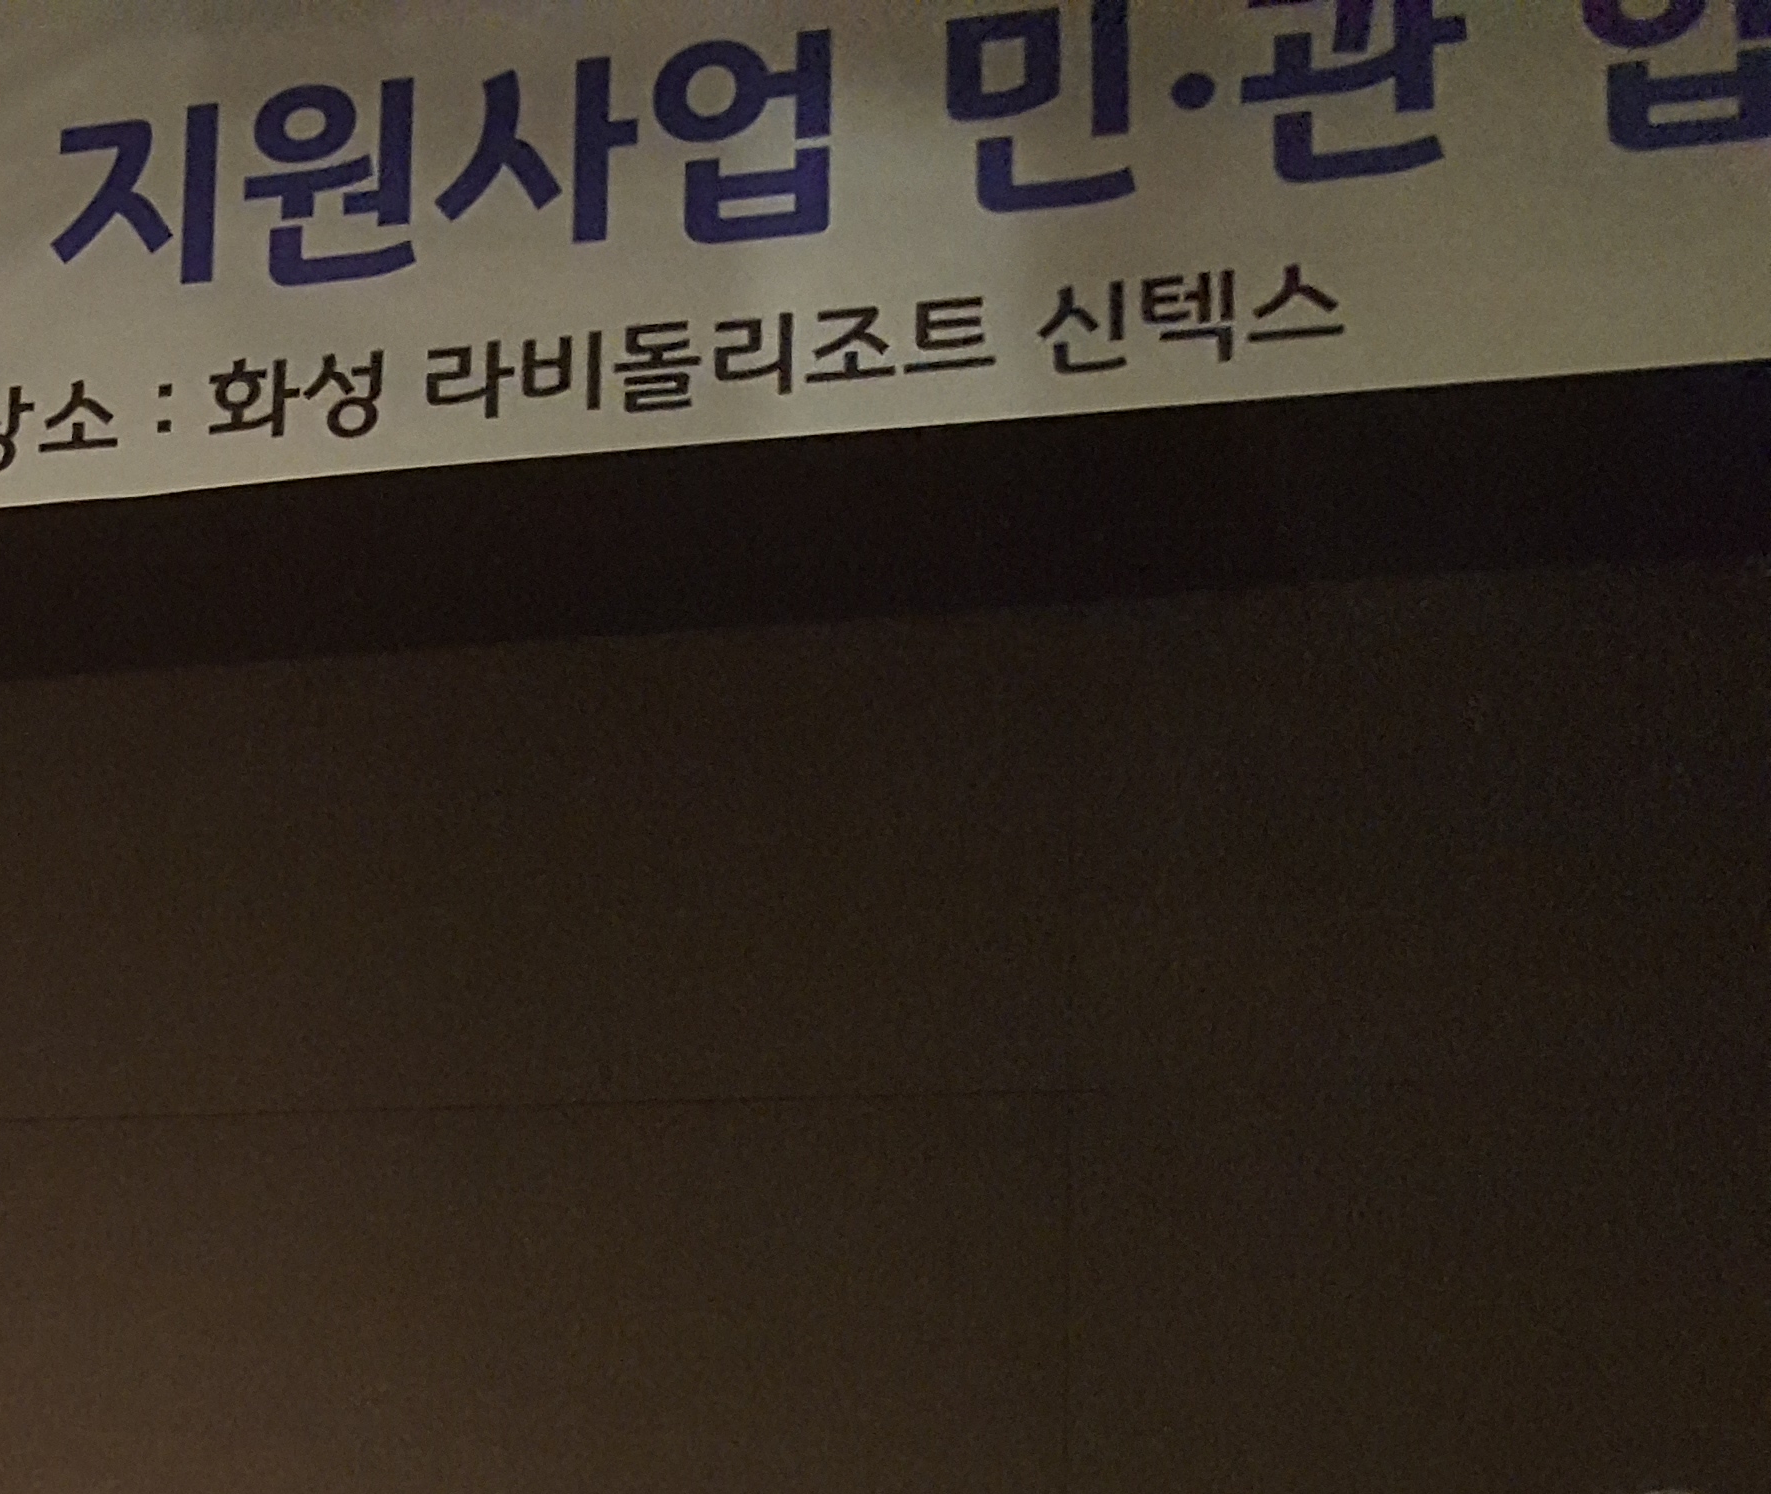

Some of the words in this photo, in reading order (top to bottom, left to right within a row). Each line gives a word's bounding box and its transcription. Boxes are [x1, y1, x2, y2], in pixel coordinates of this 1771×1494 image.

[51, 29, 833, 287] 지원사업
[207, 348, 385, 440] 화성
[425, 295, 997, 420] 라비돌리조트
[1036, 263, 1346, 375] 신텍스
